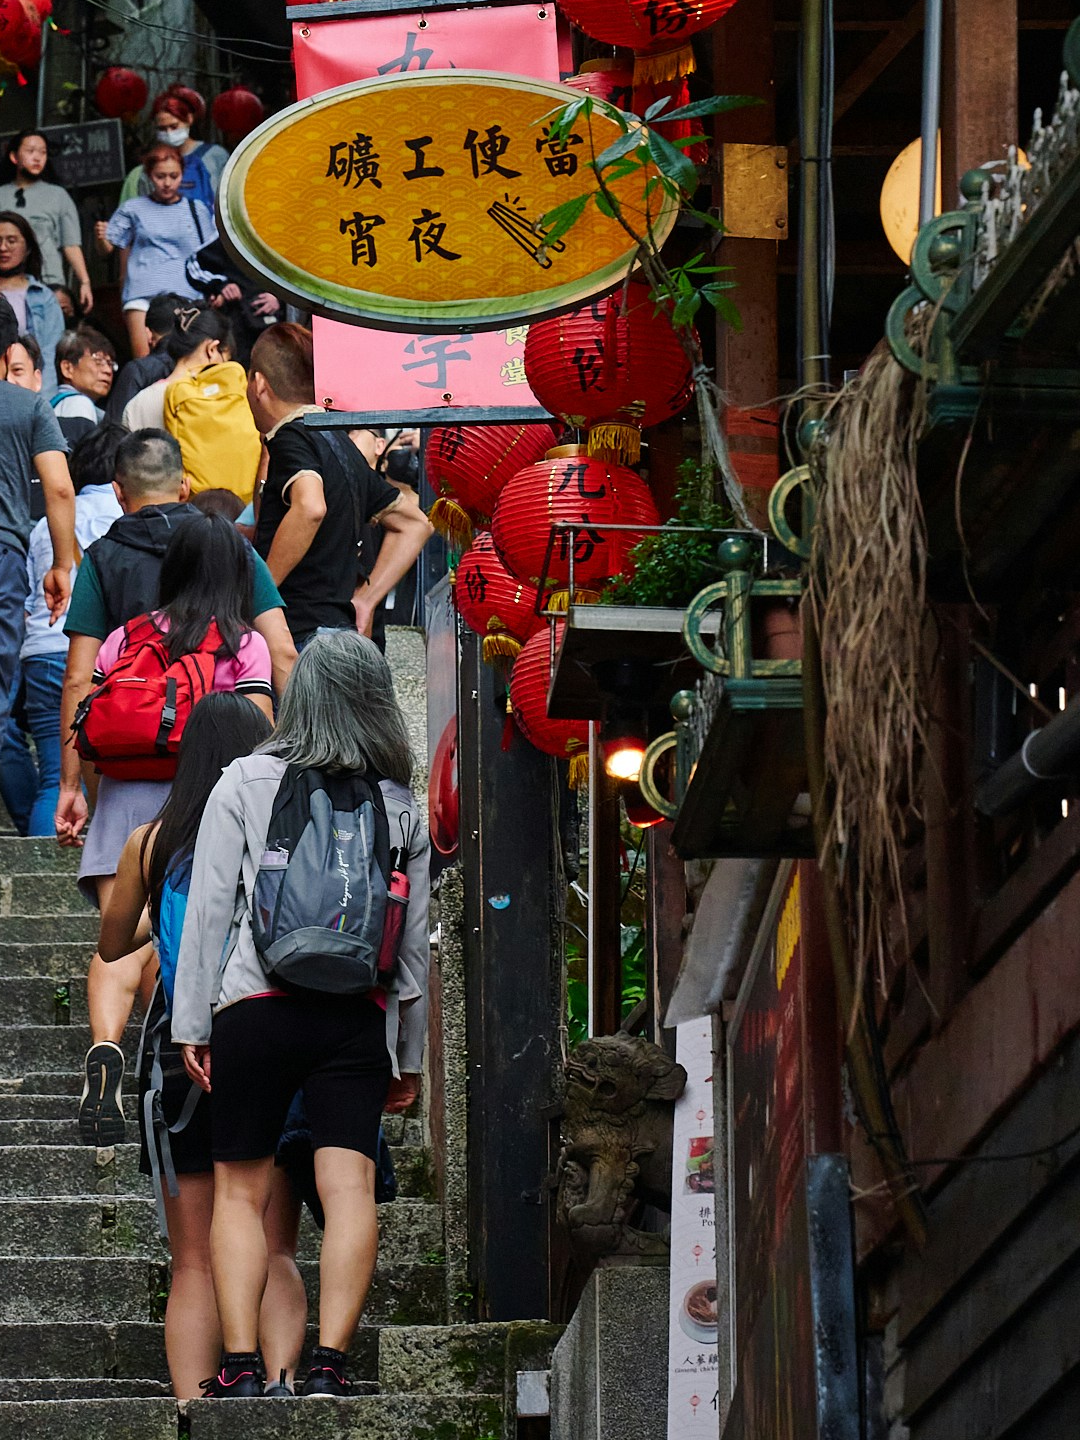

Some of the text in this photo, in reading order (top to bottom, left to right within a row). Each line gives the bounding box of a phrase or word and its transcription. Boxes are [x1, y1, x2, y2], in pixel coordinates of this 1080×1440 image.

[325, 123, 584, 189] 礦工便當
[339, 208, 462, 267] 宵夜
[557, 463, 606, 563] 九份
